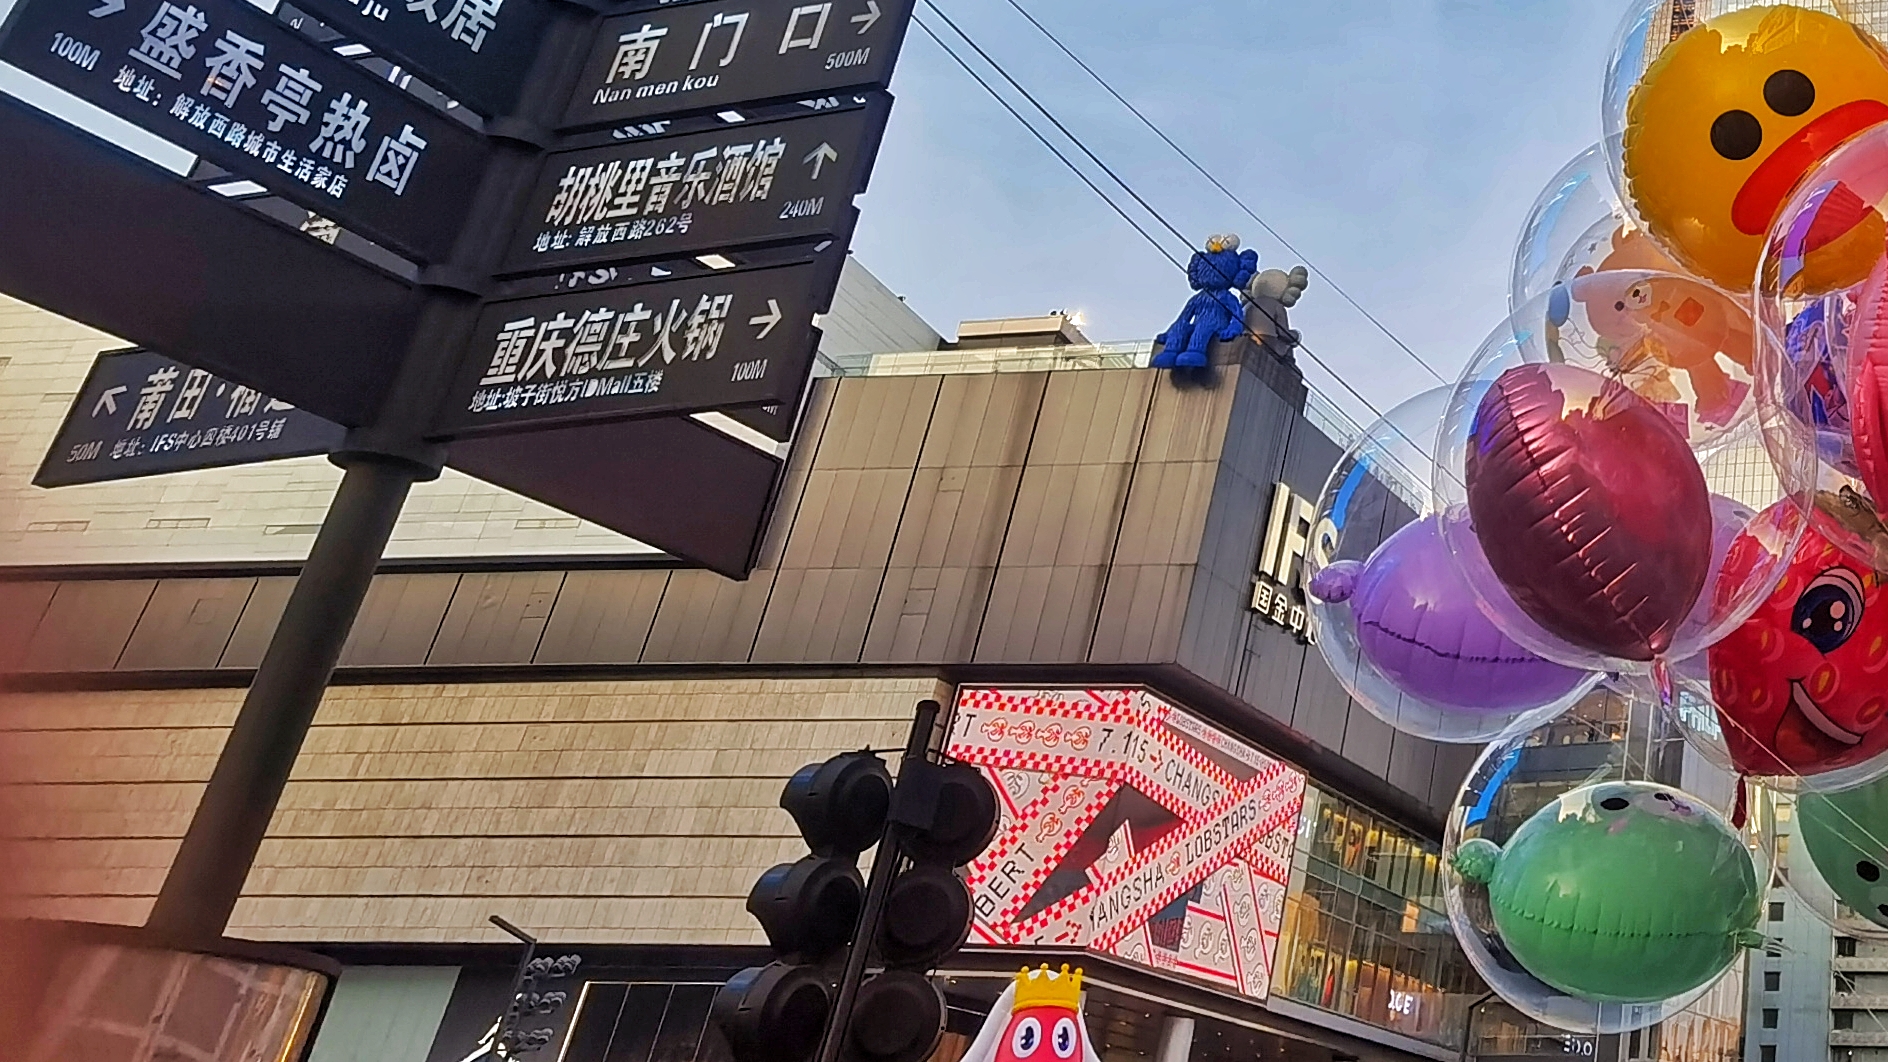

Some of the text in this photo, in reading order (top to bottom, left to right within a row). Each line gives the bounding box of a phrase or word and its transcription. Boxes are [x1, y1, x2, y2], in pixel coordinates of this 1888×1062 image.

[49, 32, 101, 71] 100M
[605, 2, 832, 84] 南门口
[824, 47, 871, 70] 500M
[128, 1, 428, 196] 盛香亭热卤
[592, 73, 720, 105] Nan men kou
[545, 137, 786, 227] 胡桃里音乐酒馆
[779, 196, 823, 220] 240M
[479, 293, 733, 386] 重庆德庄火锅
[730, 358, 767, 382] 100M
[66, 440, 103, 463] 50M
[1184, 798, 1257, 868] LOBSTARS
